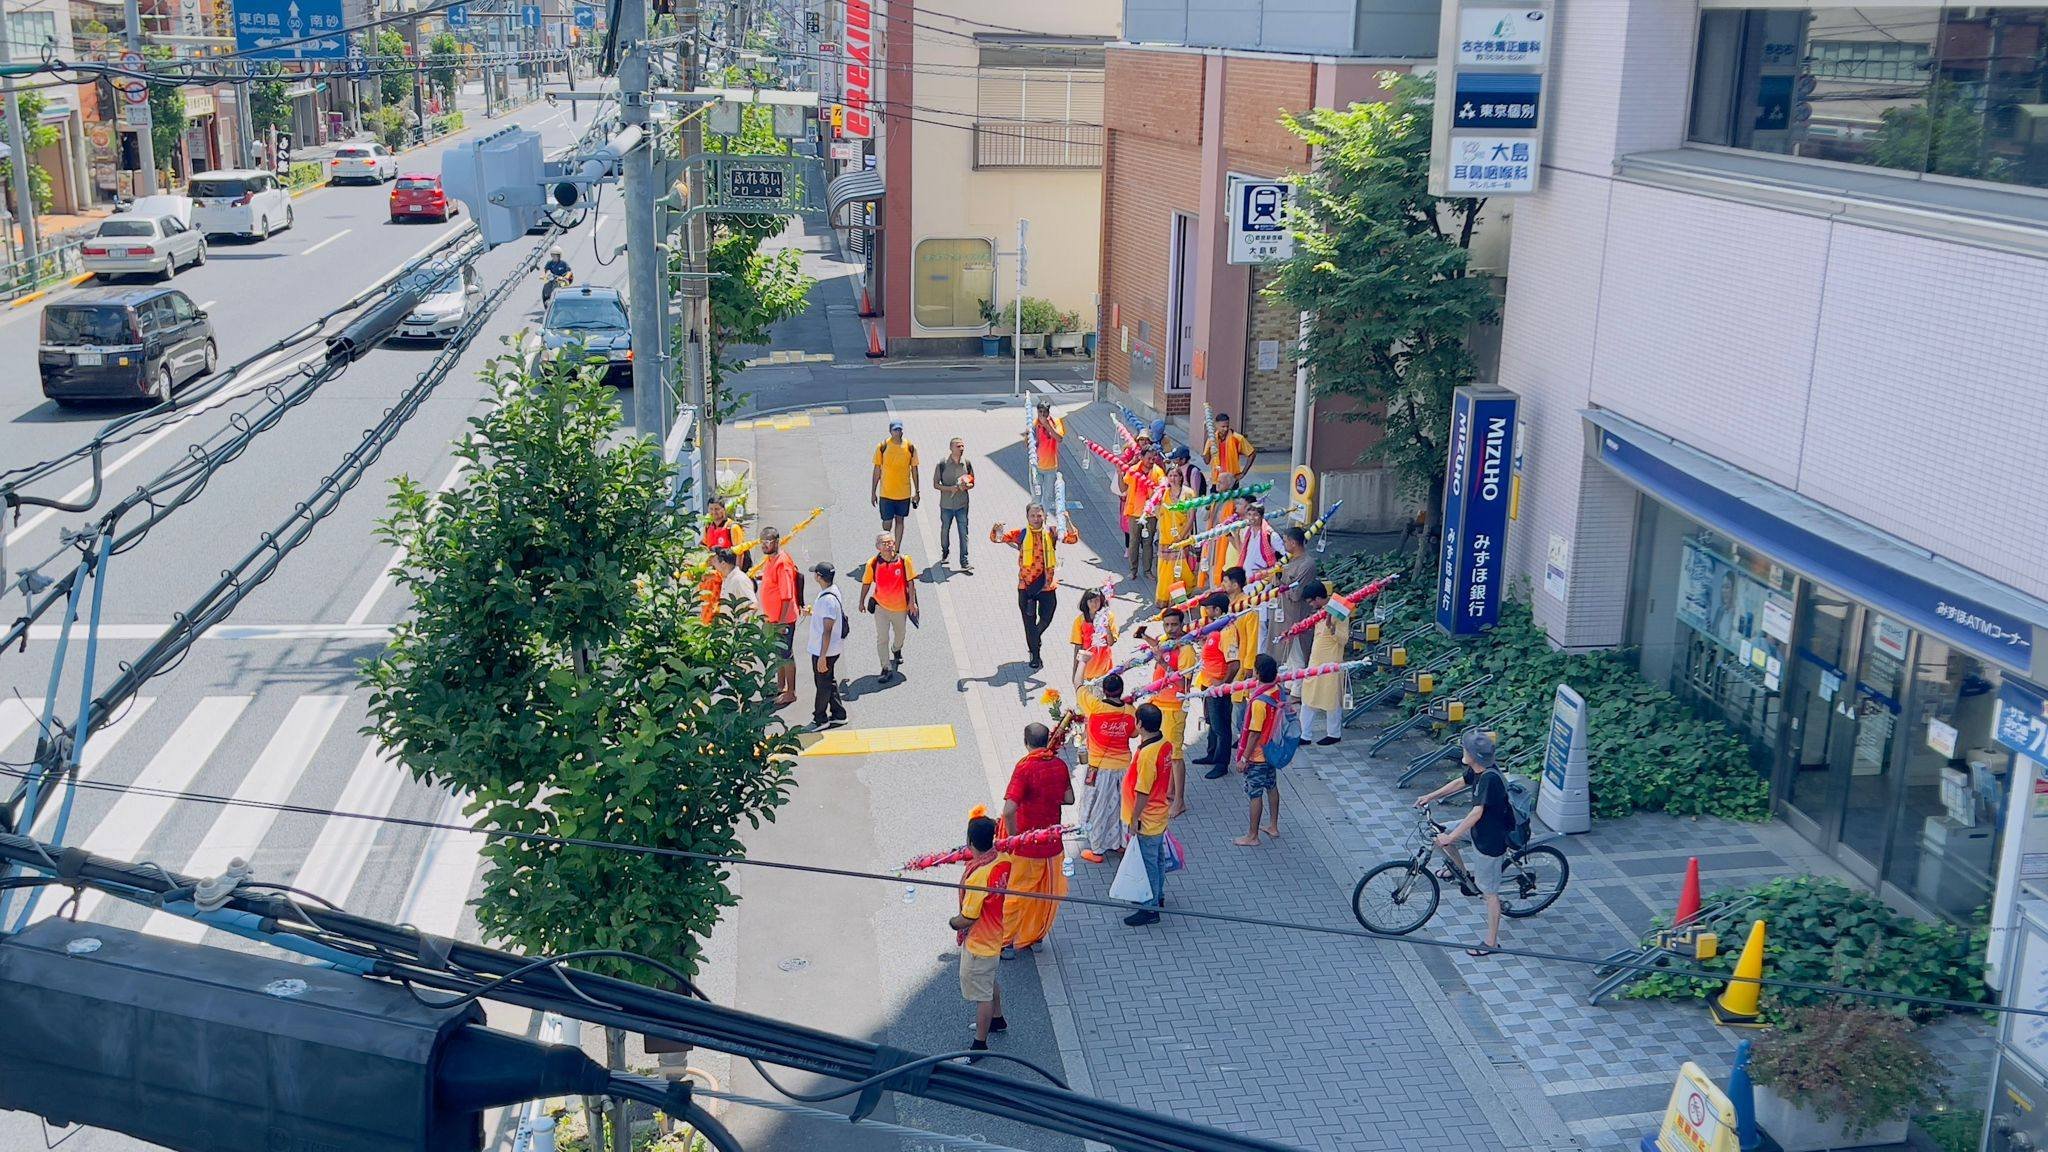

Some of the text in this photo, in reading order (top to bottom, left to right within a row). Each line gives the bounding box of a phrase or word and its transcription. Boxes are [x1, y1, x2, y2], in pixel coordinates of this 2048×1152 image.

[239, 12, 280, 26] 東向島
[310, 14, 339, 28] 南砂
[1480, 103, 1536, 119] 東京個別
[1491, 142, 1529, 162] 大島
[734, 171, 781, 186] ふれあい
[1249, 246, 1278, 255] 大島駅
[1452, 412, 1467, 496] MIZUHO
[1482, 417, 1507, 501] MIZUHO
[1468, 534, 1491, 617] みずほ銀行
